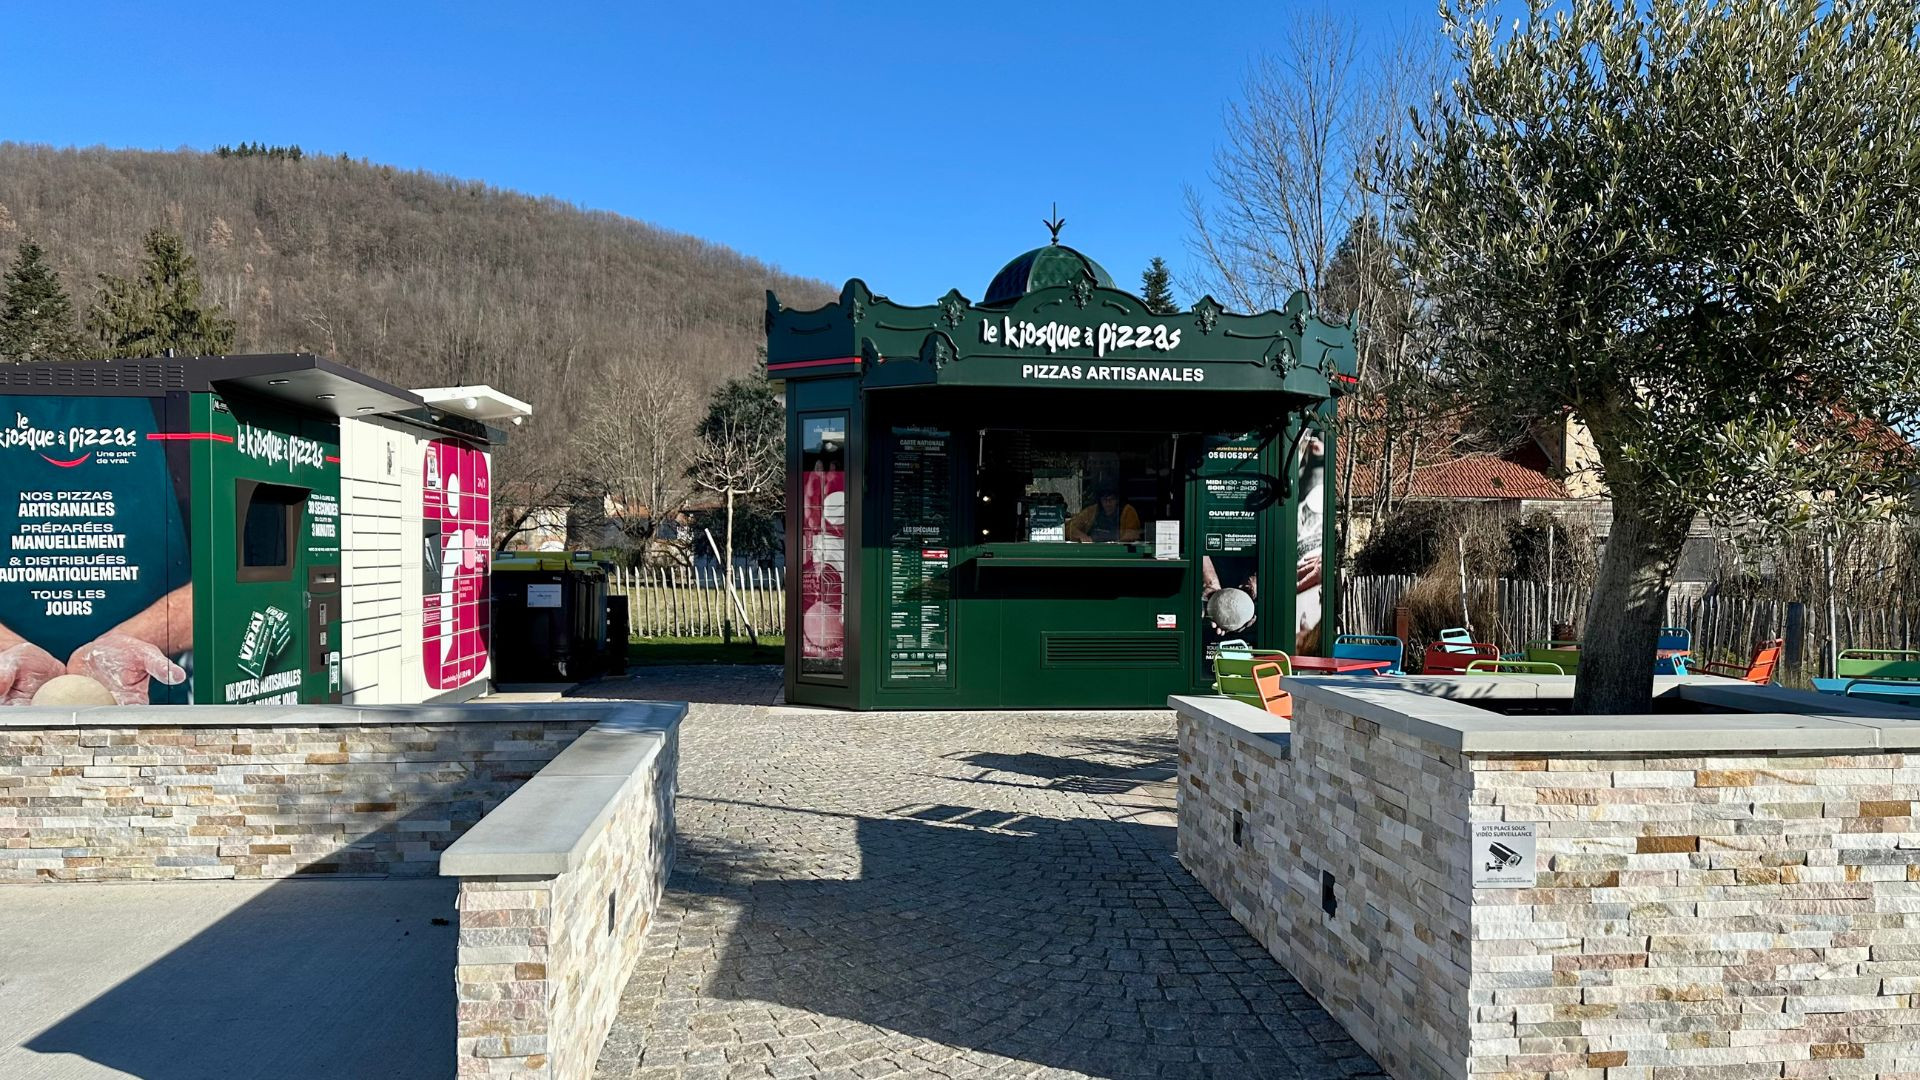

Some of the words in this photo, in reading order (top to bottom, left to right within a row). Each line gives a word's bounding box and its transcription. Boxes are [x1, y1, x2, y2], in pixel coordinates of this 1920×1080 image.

[983, 318, 998, 343] le
[1004, 316, 1080, 353] kiosque
[1084, 328, 1094, 347] à
[1098, 322, 1182, 358] pizzas
[1022, 364, 1082, 380] PIZZAS
[1087, 366, 1204, 382] ARTISANALES
[16, 411, 29, 429] le
[58, 430, 66, 446] à
[69, 427, 136, 453] pizzas
[237, 424, 245, 453] le
[247, 421, 282, 466] kiosque
[283, 439, 289, 461] à
[289, 435, 323, 473] pizzas
[916, 439, 944, 447] NATIONALE
[1208, 451, 1219, 459] 05
[1227, 451, 1237, 459] 05
[20, 491, 53, 501] NOS
[57, 491, 113, 501] PIZZAS
[18, 502, 115, 517] ARTISANALES
[307, 500, 314, 514] 30
[314, 501, 338, 516] SECONDES
[21, 521, 114, 533] PRÉPARÉES
[311, 522, 315, 537] 3
[315, 523, 336, 537] MINUTES
[11, 534, 126, 550] MANUELLEMENT
[9, 556, 21, 566] &
[25, 553, 126, 565] DISTRIBUÉES
[0, 566, 139, 582] AUTOMATIQUEMENT
[31, 590, 73, 599] TOUS
[78, 590, 106, 599] LES
[45, 601, 92, 616] JOURS
[265, 605, 288, 622] VRAI
[240, 611, 264, 661] VRAI
[225, 682, 235, 702] NOS
[235, 678, 260, 700] PIZZAS
[260, 668, 301, 694] ARTISANALES
[282, 690, 298, 705] JOUR
